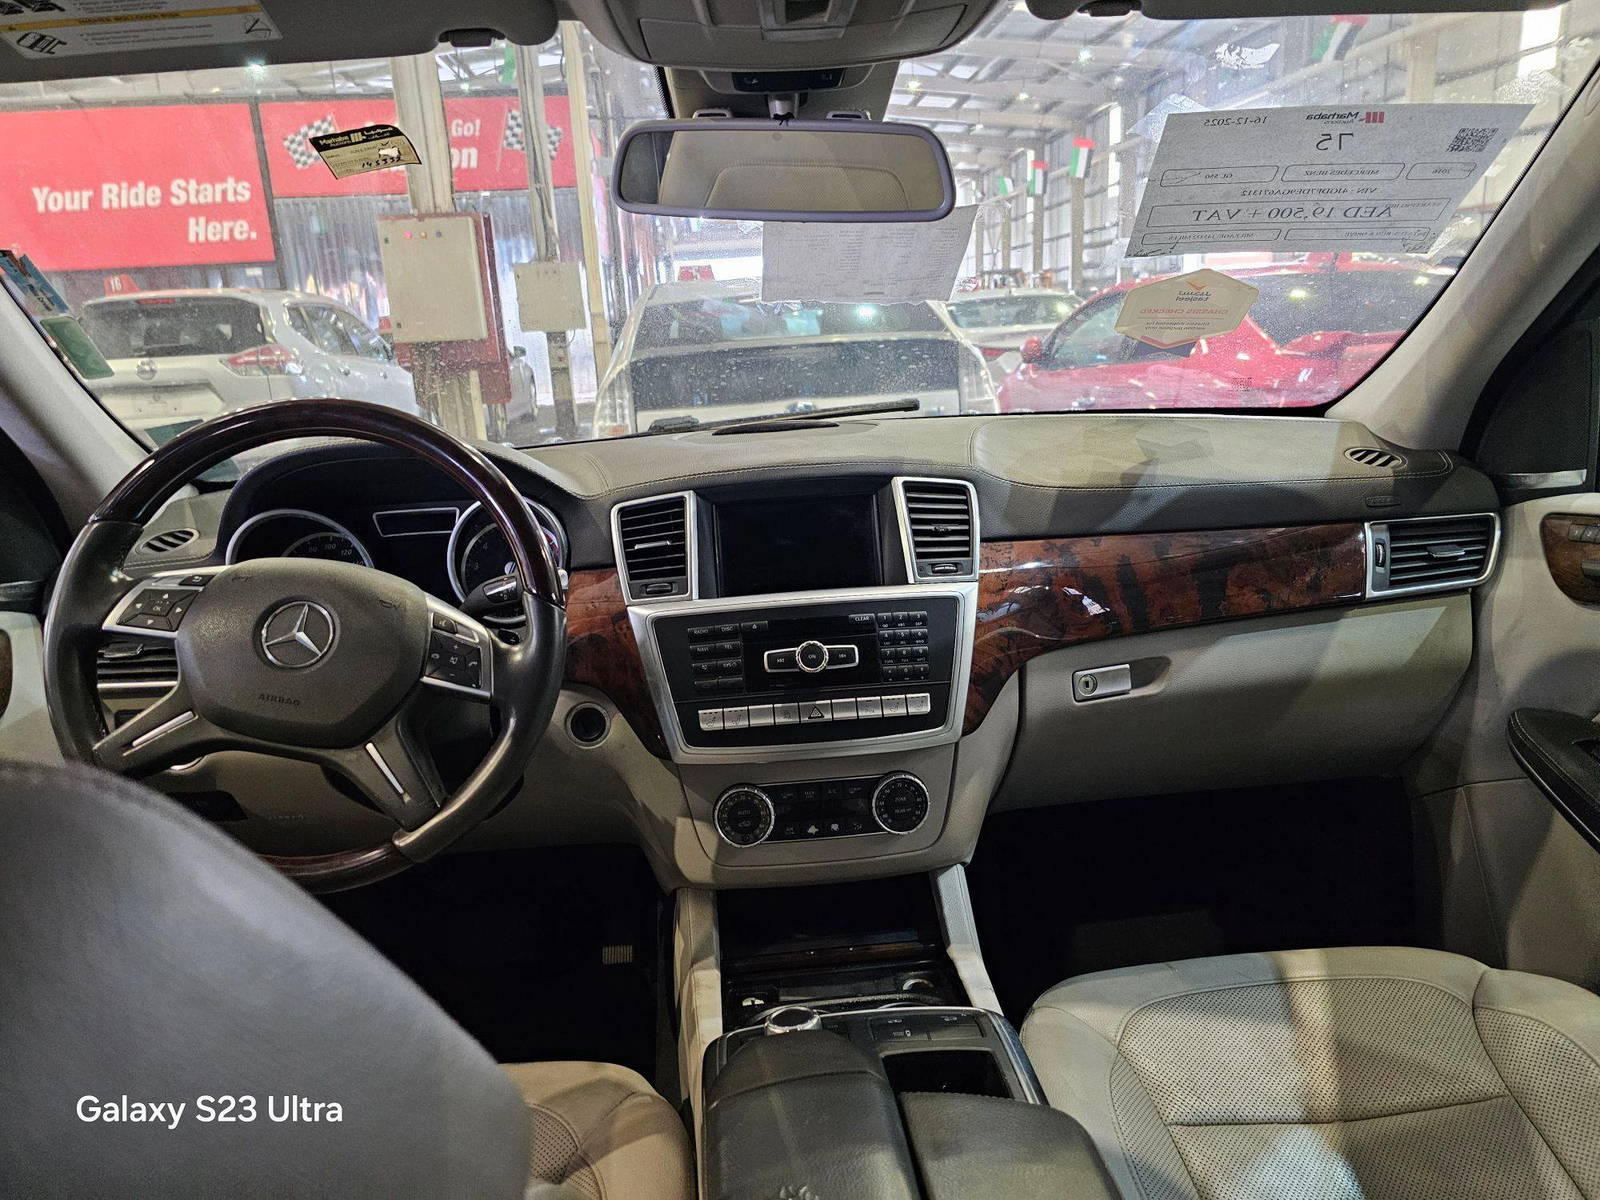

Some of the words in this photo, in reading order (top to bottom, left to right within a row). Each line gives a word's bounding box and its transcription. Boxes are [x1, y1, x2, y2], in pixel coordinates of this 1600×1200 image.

[451, 119, 481, 137] Go!
[32, 186, 93, 213] Your
[102, 181, 162, 210] Ride
[170, 176, 251, 206] Starts
[188, 216, 257, 243] Here.
